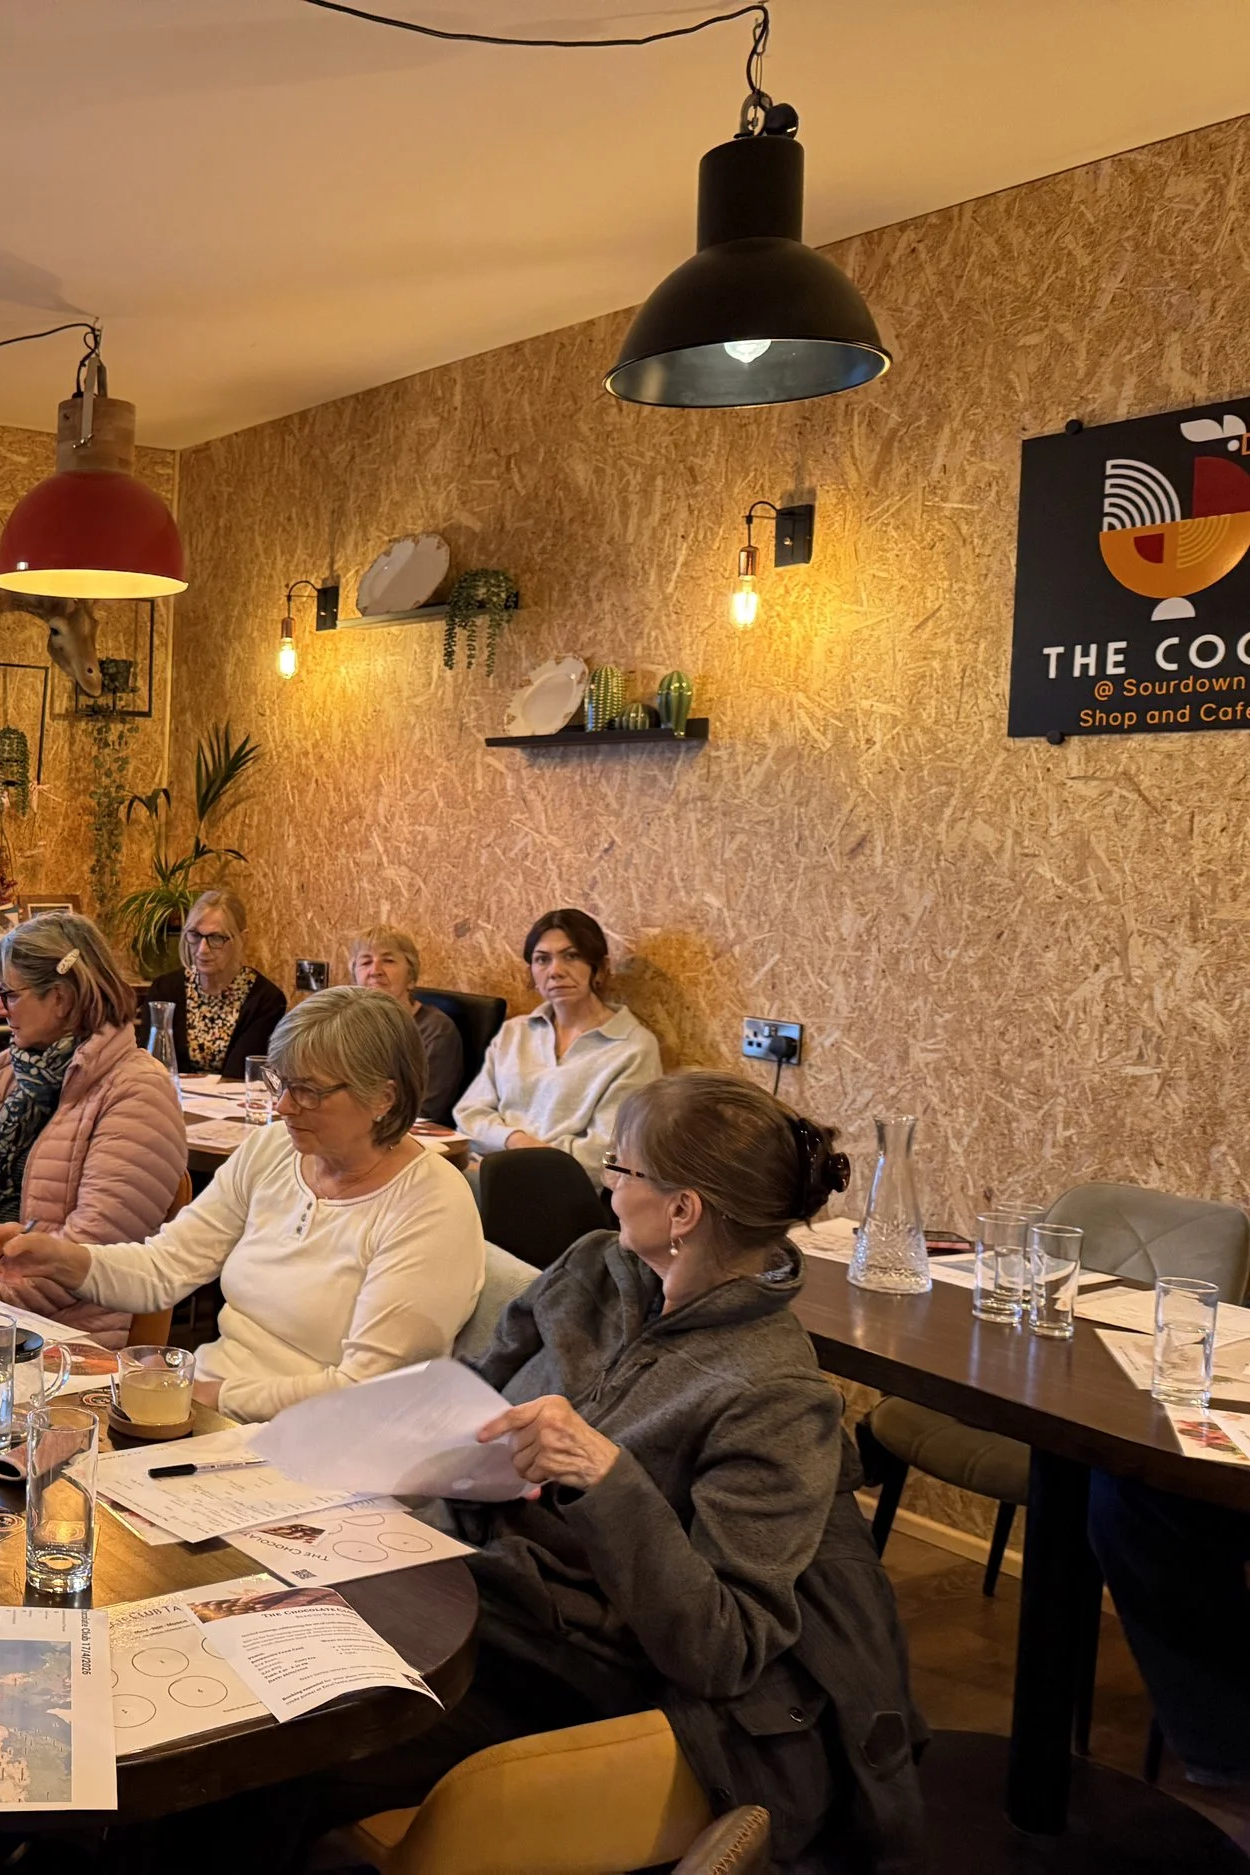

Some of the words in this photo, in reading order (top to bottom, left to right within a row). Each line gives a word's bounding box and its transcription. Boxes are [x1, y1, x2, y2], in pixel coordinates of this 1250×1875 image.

[1042, 641, 1128, 679] THE
[1123, 675, 1246, 697] Sourdown
[1079, 709, 1137, 729] Shop
[1146, 704, 1190, 724] and
[304, 1550, 329, 1561] THE
[81, 1627, 91, 1641] Club
